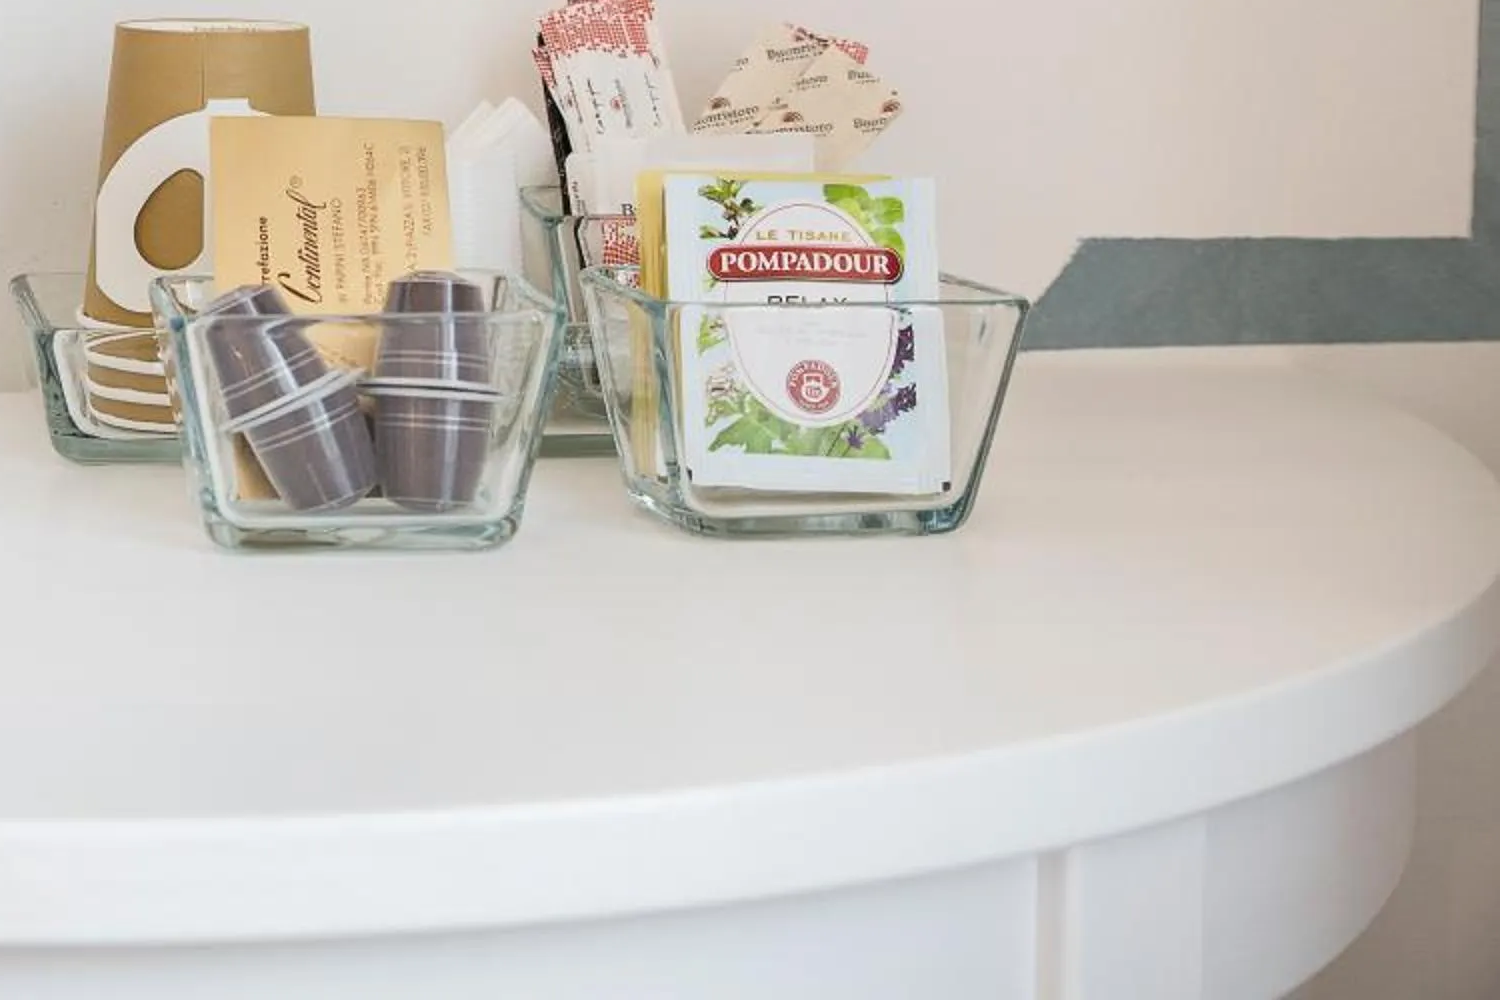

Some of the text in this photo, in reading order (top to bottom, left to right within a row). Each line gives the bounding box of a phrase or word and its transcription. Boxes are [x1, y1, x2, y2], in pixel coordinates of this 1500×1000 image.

[756, 229, 849, 242] LE TISANE
[720, 250, 892, 276] POMPADOUR
